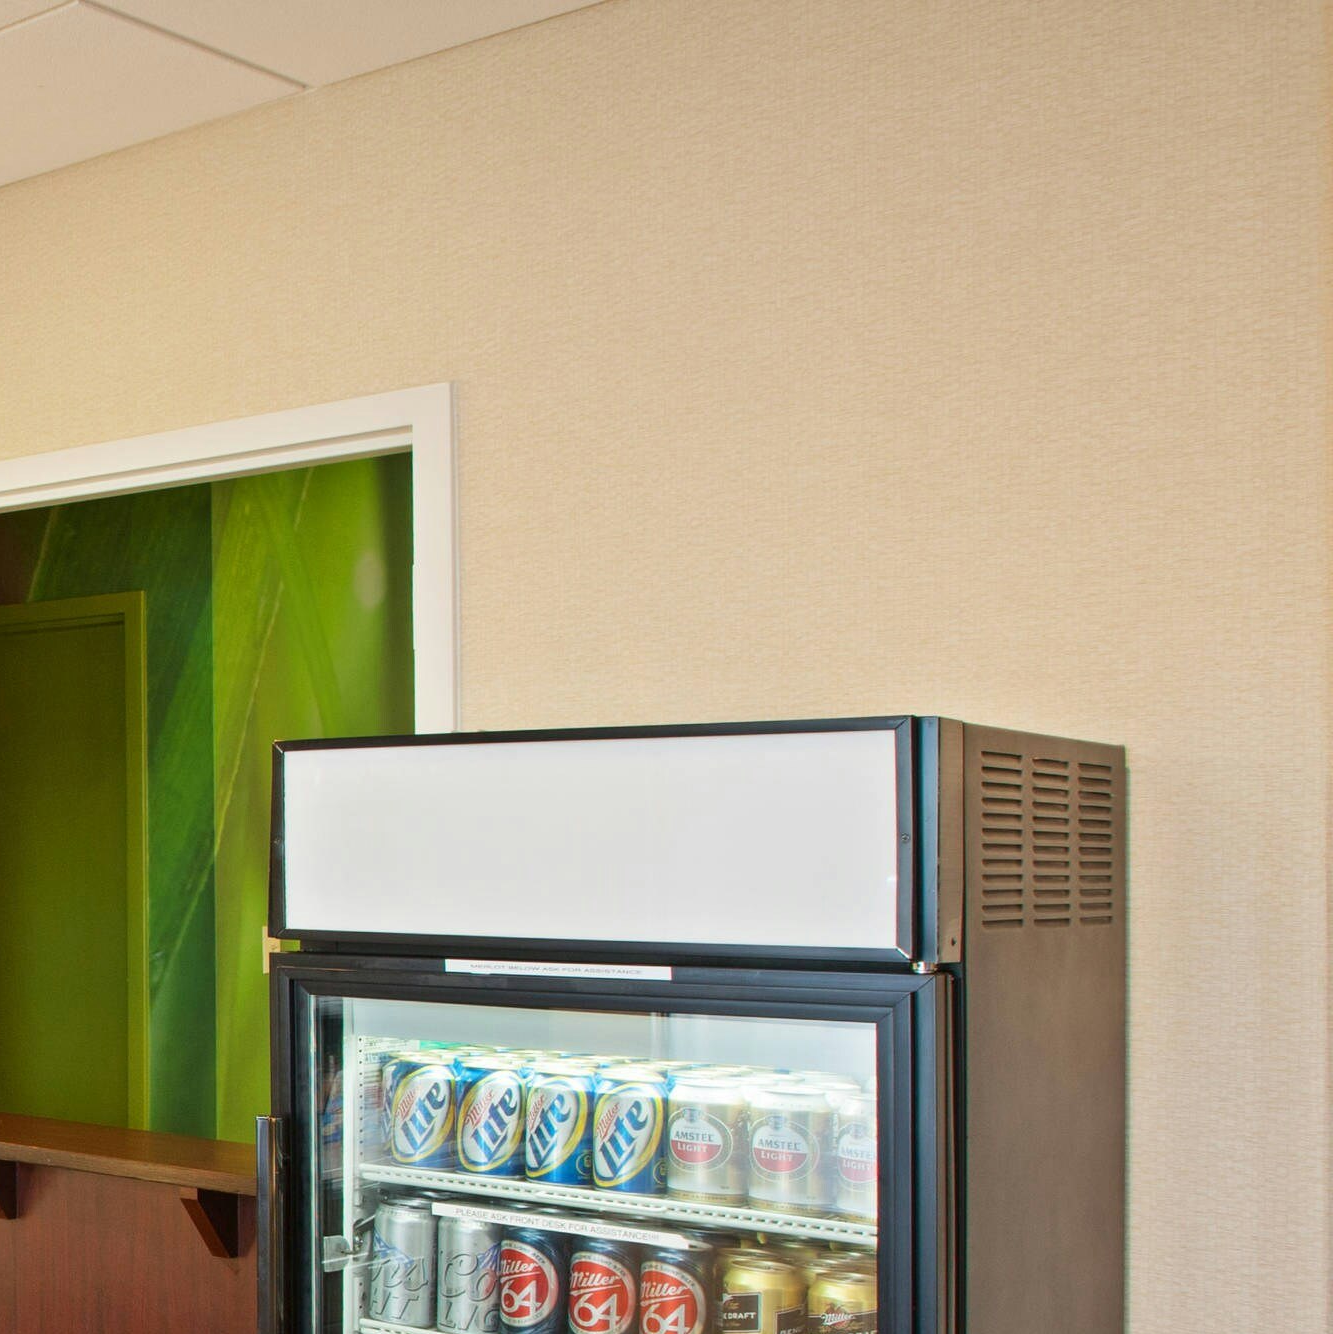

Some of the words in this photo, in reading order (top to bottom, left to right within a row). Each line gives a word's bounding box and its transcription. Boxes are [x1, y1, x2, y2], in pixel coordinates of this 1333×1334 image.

[674, 1130, 715, 1143] AMSTEL
[676, 1142, 709, 1154] LIGHT
[757, 1138, 801, 1151] AMSTEL
[760, 1150, 794, 1163] LIGHT
[841, 1145, 875, 1159] AMSTE
[455, 1207, 488, 1219] PLEASE
[490, 1212, 509, 1222] ASK
[509, 1214, 541, 1226] FRONT
[541, 1219, 567, 1230] DESK
[568, 1222, 589, 1233] FOR
[570, 1270, 620, 1289] Miller
[501, 1276, 541, 1314] 64
[573, 1290, 625, 1329] 64
[728, 1312, 756, 1320] DRAFT
